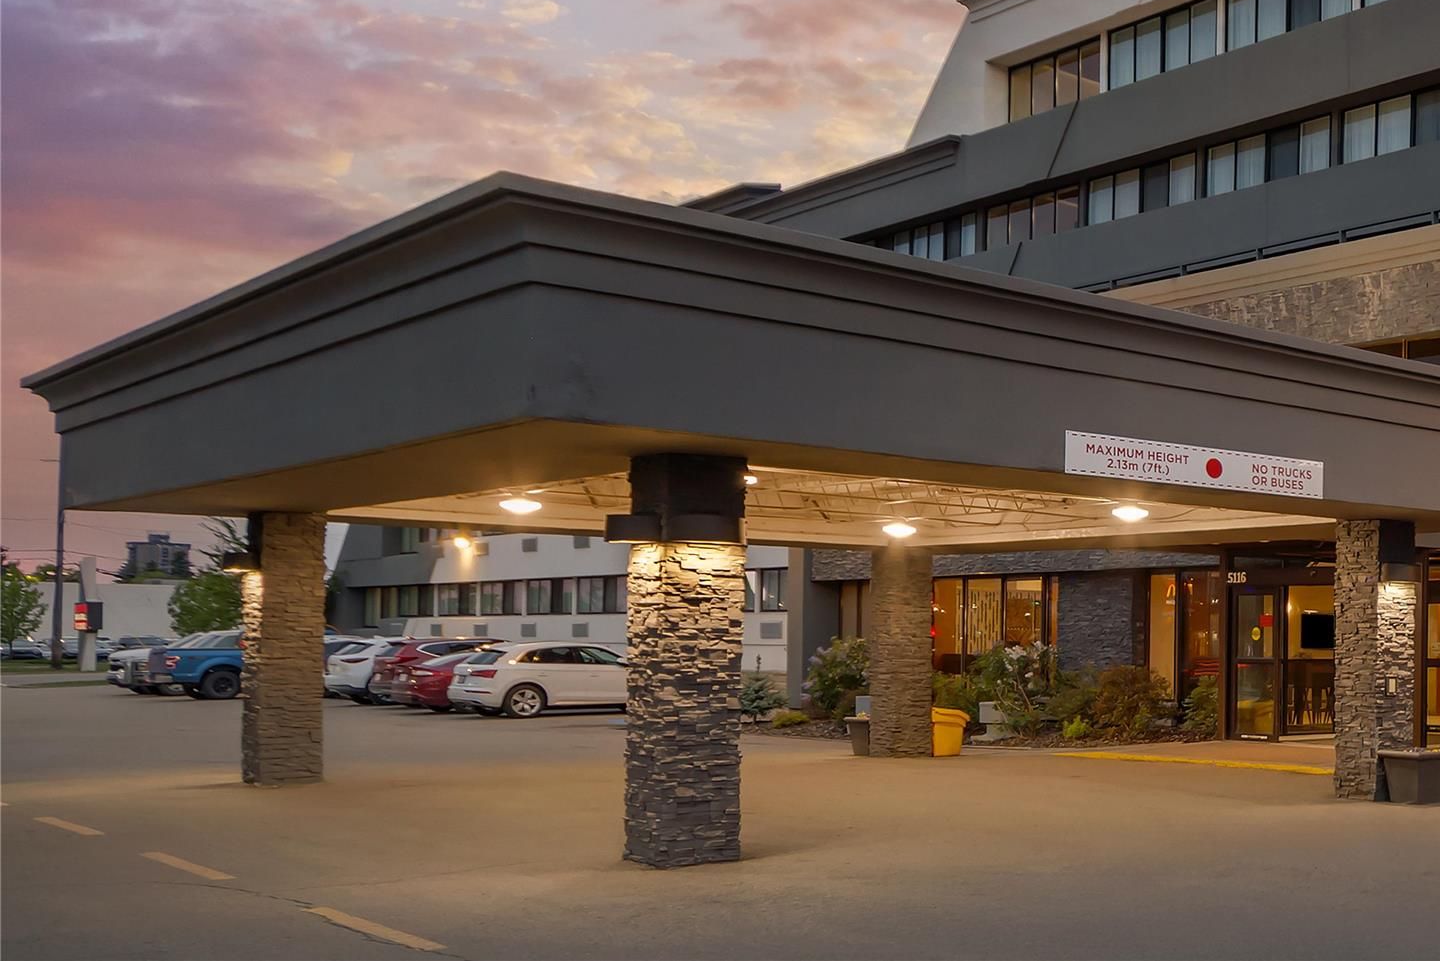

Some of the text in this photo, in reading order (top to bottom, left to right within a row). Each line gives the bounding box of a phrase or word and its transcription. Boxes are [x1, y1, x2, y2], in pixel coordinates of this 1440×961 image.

[1085, 443, 1190, 465] MAXIMUM HEIGHT
[1106, 458, 1170, 476] 2.13m (7ft.)
[1251, 463, 1313, 480] NO TRUCKS
[1251, 475, 1304, 490] OR BUSES
[1227, 571, 1247, 583] 5116
